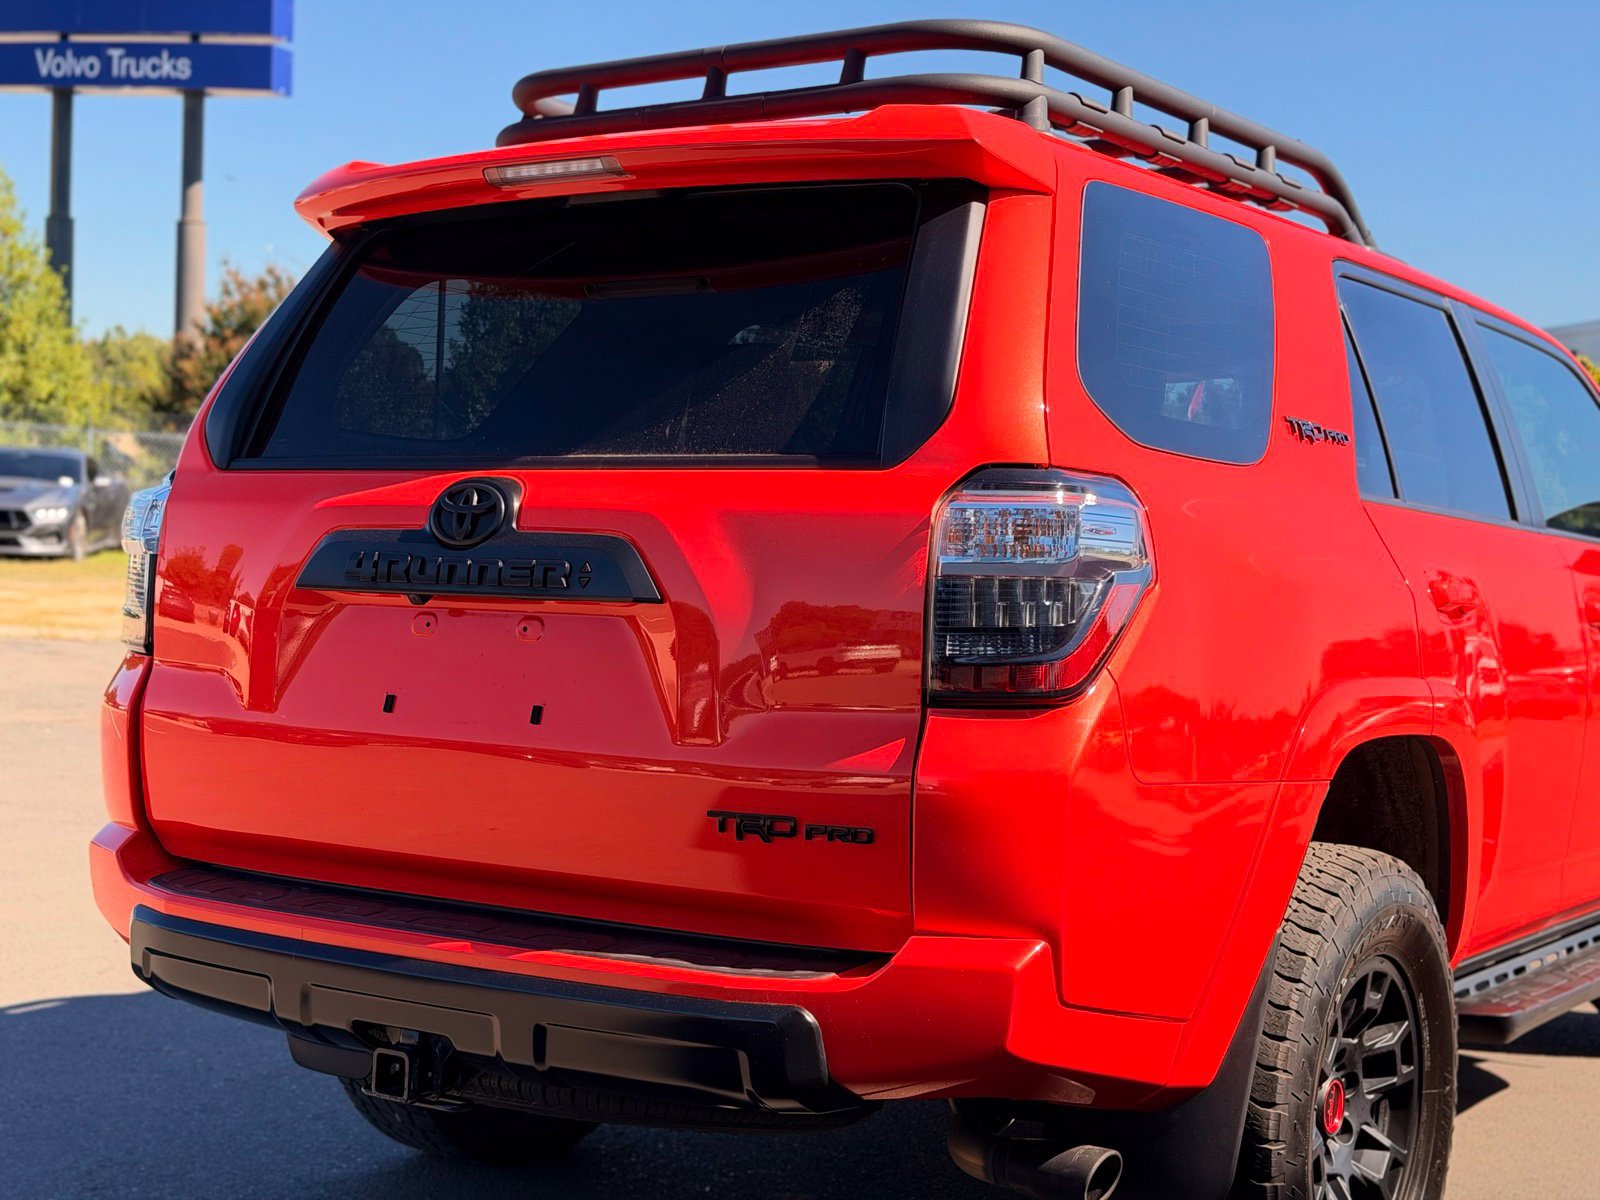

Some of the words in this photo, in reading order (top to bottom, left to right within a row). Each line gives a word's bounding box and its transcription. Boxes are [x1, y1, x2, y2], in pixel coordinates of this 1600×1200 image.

[34, 48, 100, 79] Volvo
[106, 48, 193, 80] Trucks
[1284, 415, 1324, 445] TRD
[344, 550, 572, 588] 4RUNNER
[706, 810, 798, 844] TRD
[804, 823, 875, 845] PRO
